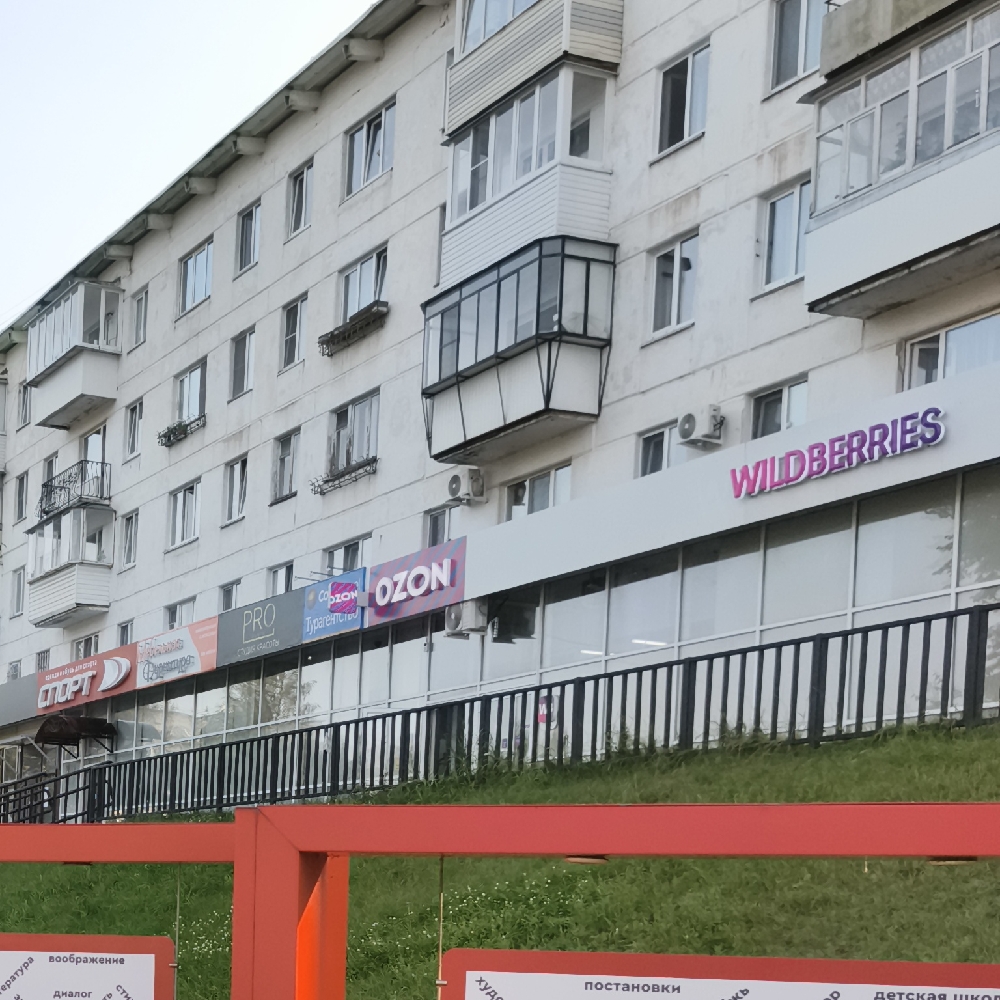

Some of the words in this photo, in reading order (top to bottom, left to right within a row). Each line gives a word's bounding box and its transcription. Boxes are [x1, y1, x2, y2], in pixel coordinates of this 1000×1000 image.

[730, 407, 944, 499] WILDBERRIES
[375, 558, 453, 606] OZON
[328, 588, 358, 608] OZON
[38, 671, 97, 708] СПОРТ
[48, 954, 125, 966] воображение
[53, 989, 92, 1000] диалог
[585, 982, 680, 994] постановки
